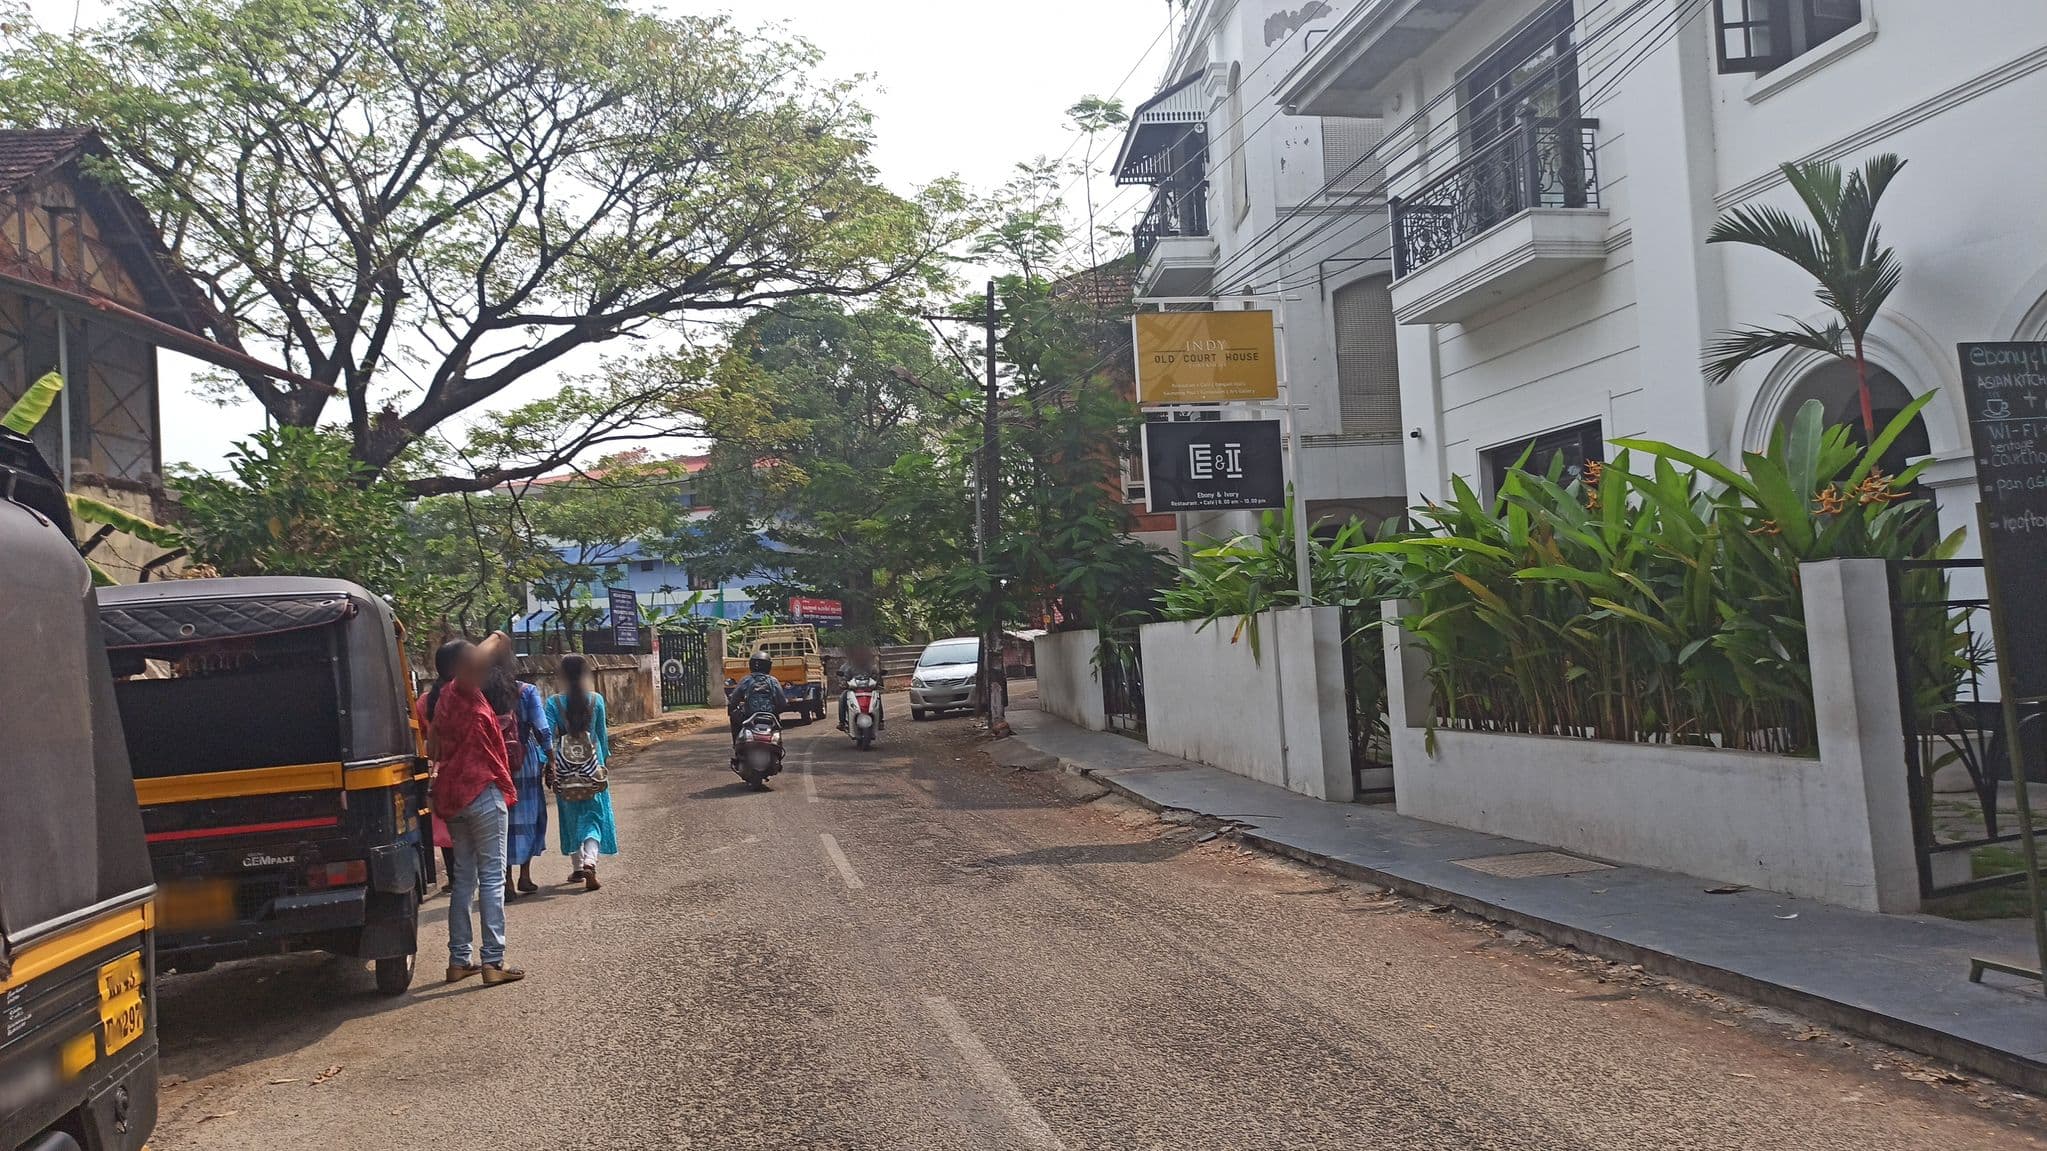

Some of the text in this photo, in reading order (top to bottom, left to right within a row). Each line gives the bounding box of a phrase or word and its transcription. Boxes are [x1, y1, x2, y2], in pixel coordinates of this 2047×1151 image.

[1186, 339, 1226, 351] INDY
[1154, 352, 1259, 363] OLD COURT HOUSE
